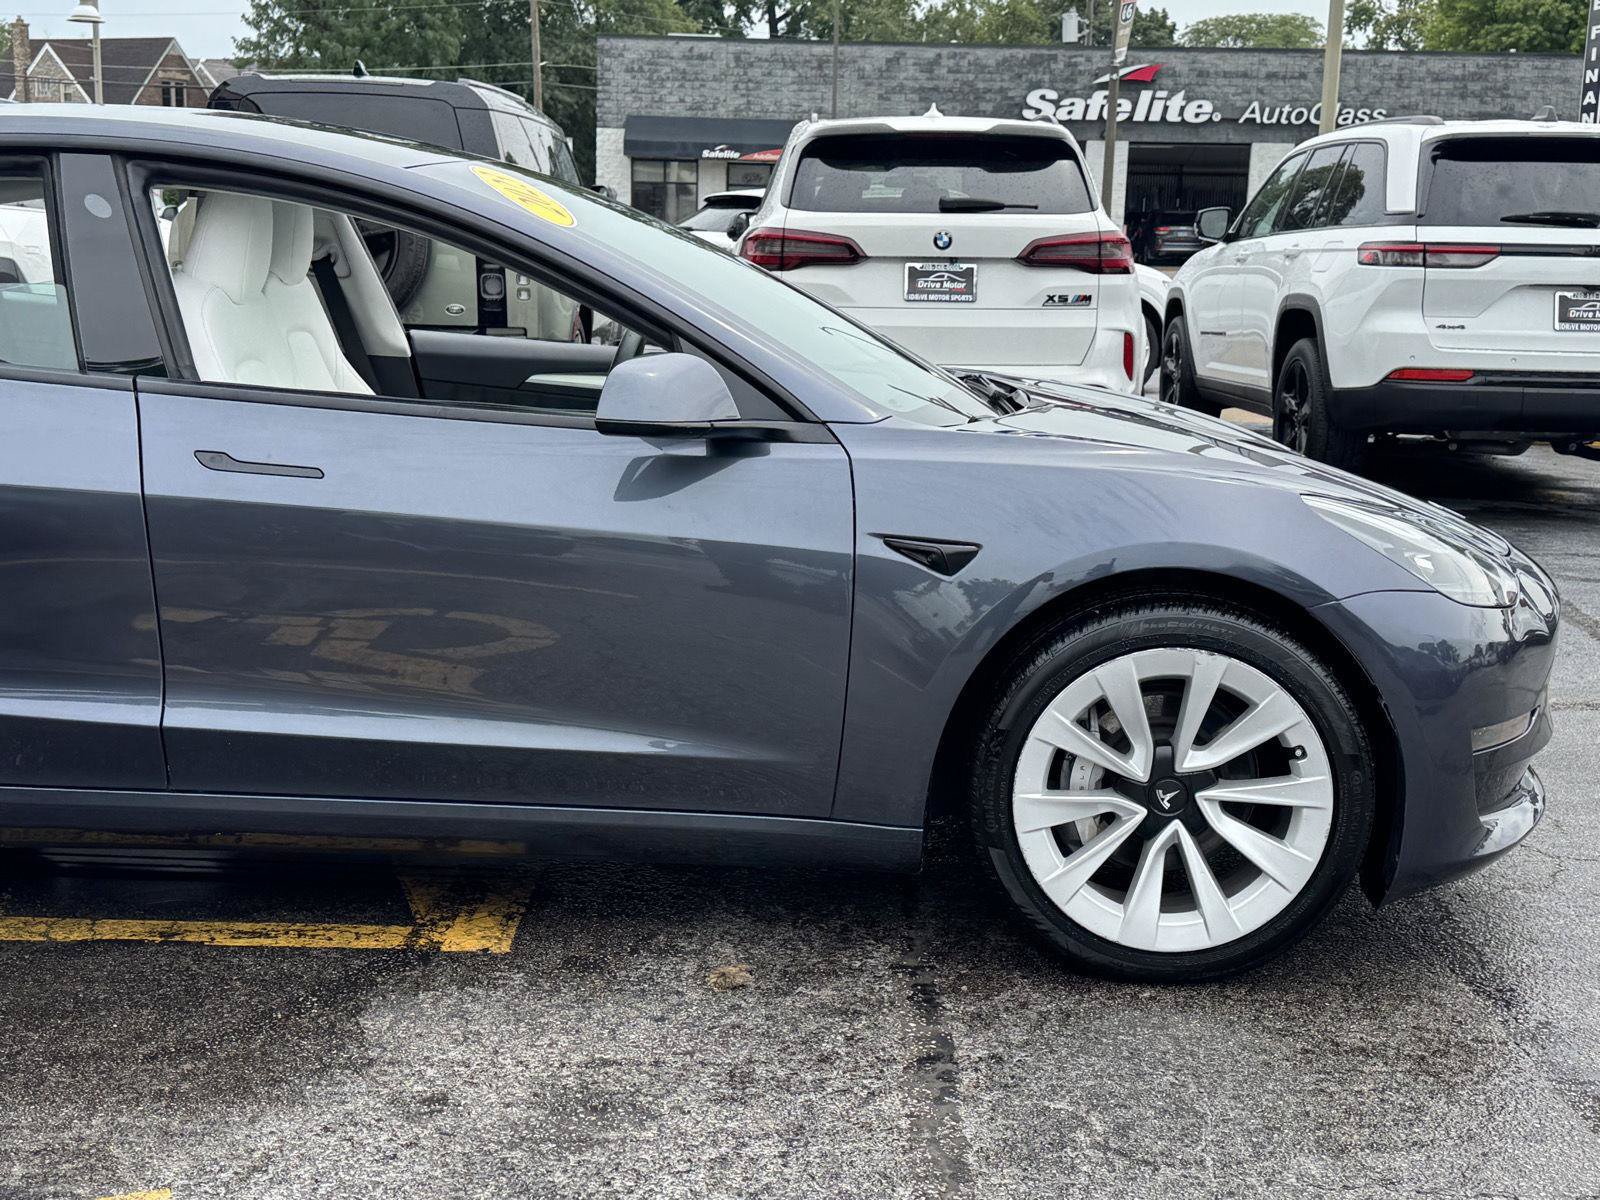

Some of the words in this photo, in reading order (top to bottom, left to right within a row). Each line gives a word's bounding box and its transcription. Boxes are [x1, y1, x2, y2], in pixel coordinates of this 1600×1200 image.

[1022, 88, 1212, 123] Safelite
[701, 149, 740, 159] Safelite
[917, 280, 941, 289] Drive
[942, 281, 967, 289] Motor
[950, 294, 973, 302] SPORTS
[1044, 294, 1069, 303] X5
[1569, 309, 1594, 318] Drive
